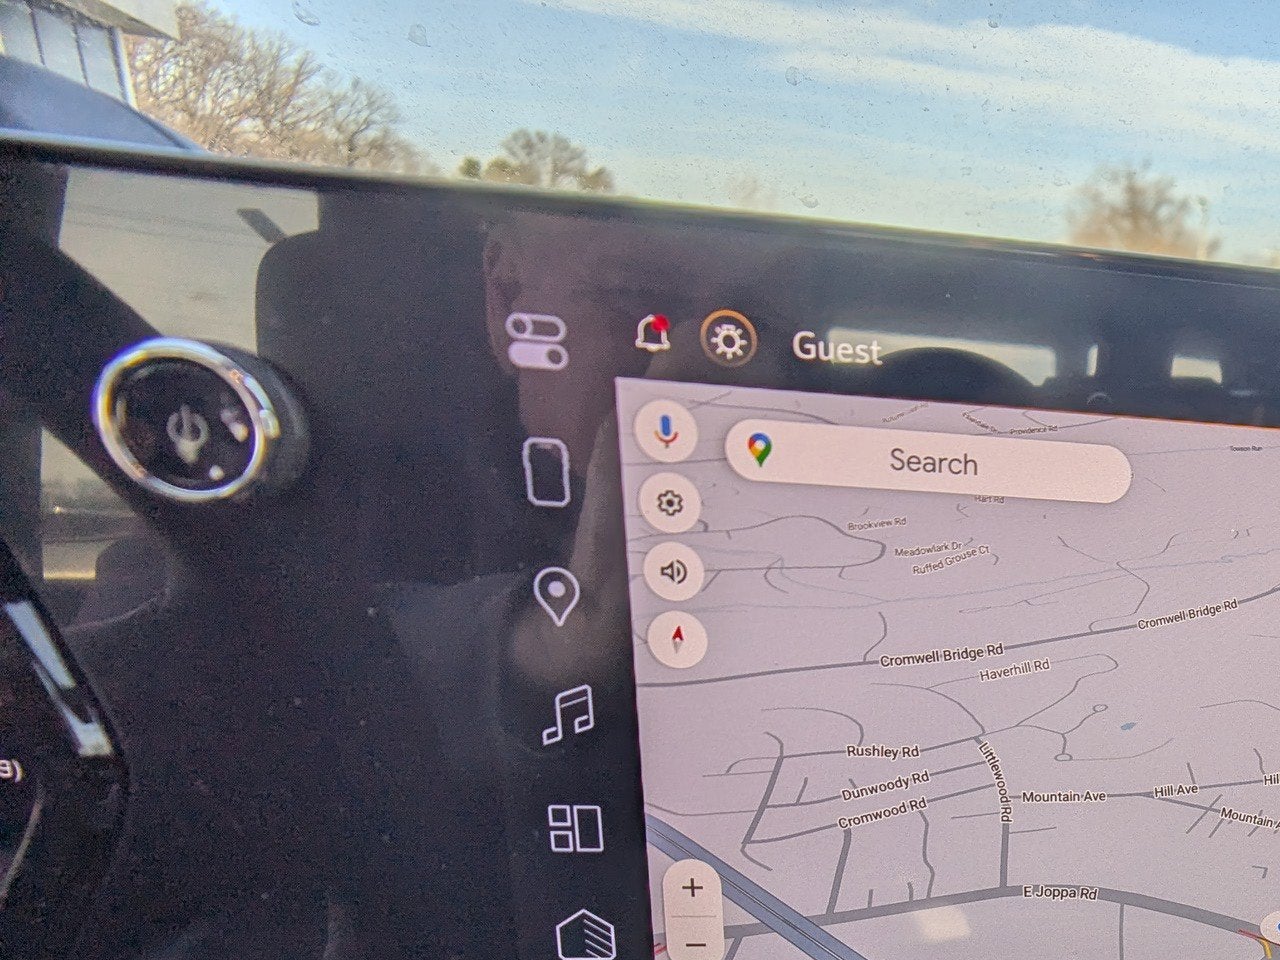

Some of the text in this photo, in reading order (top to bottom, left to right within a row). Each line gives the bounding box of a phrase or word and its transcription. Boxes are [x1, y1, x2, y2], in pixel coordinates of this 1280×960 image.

[792, 330, 884, 366] Guest
[1010, 427, 1047, 435] Providence
[890, 447, 978, 476] Search
[995, 496, 1005, 505] Rd
[848, 517, 907, 531] Brookview Rd
[894, 541, 963, 557] Meadowlark Dr
[912, 545, 990, 575] Ruffed Grouse Ct
[1137, 599, 1238, 630] Cromwell Bridge Rd
[880, 643, 1004, 668] Cromwell Bridge Rd
[980, 658, 1050, 681] Haverhill Rd
[846, 745, 920, 760] Rushley Rd
[841, 770, 930, 801] Dunwoody Rd
[978, 742, 1012, 823] Littlewood Rd
[1154, 784, 1199, 798] Hill Ave
[1022, 790, 1106, 803] Mountain Ave
[838, 797, 927, 829] Cromwood Rd
[1220, 807, 1274, 828] Mountain
[1023, 886, 1098, 901] E Joppa Rd
